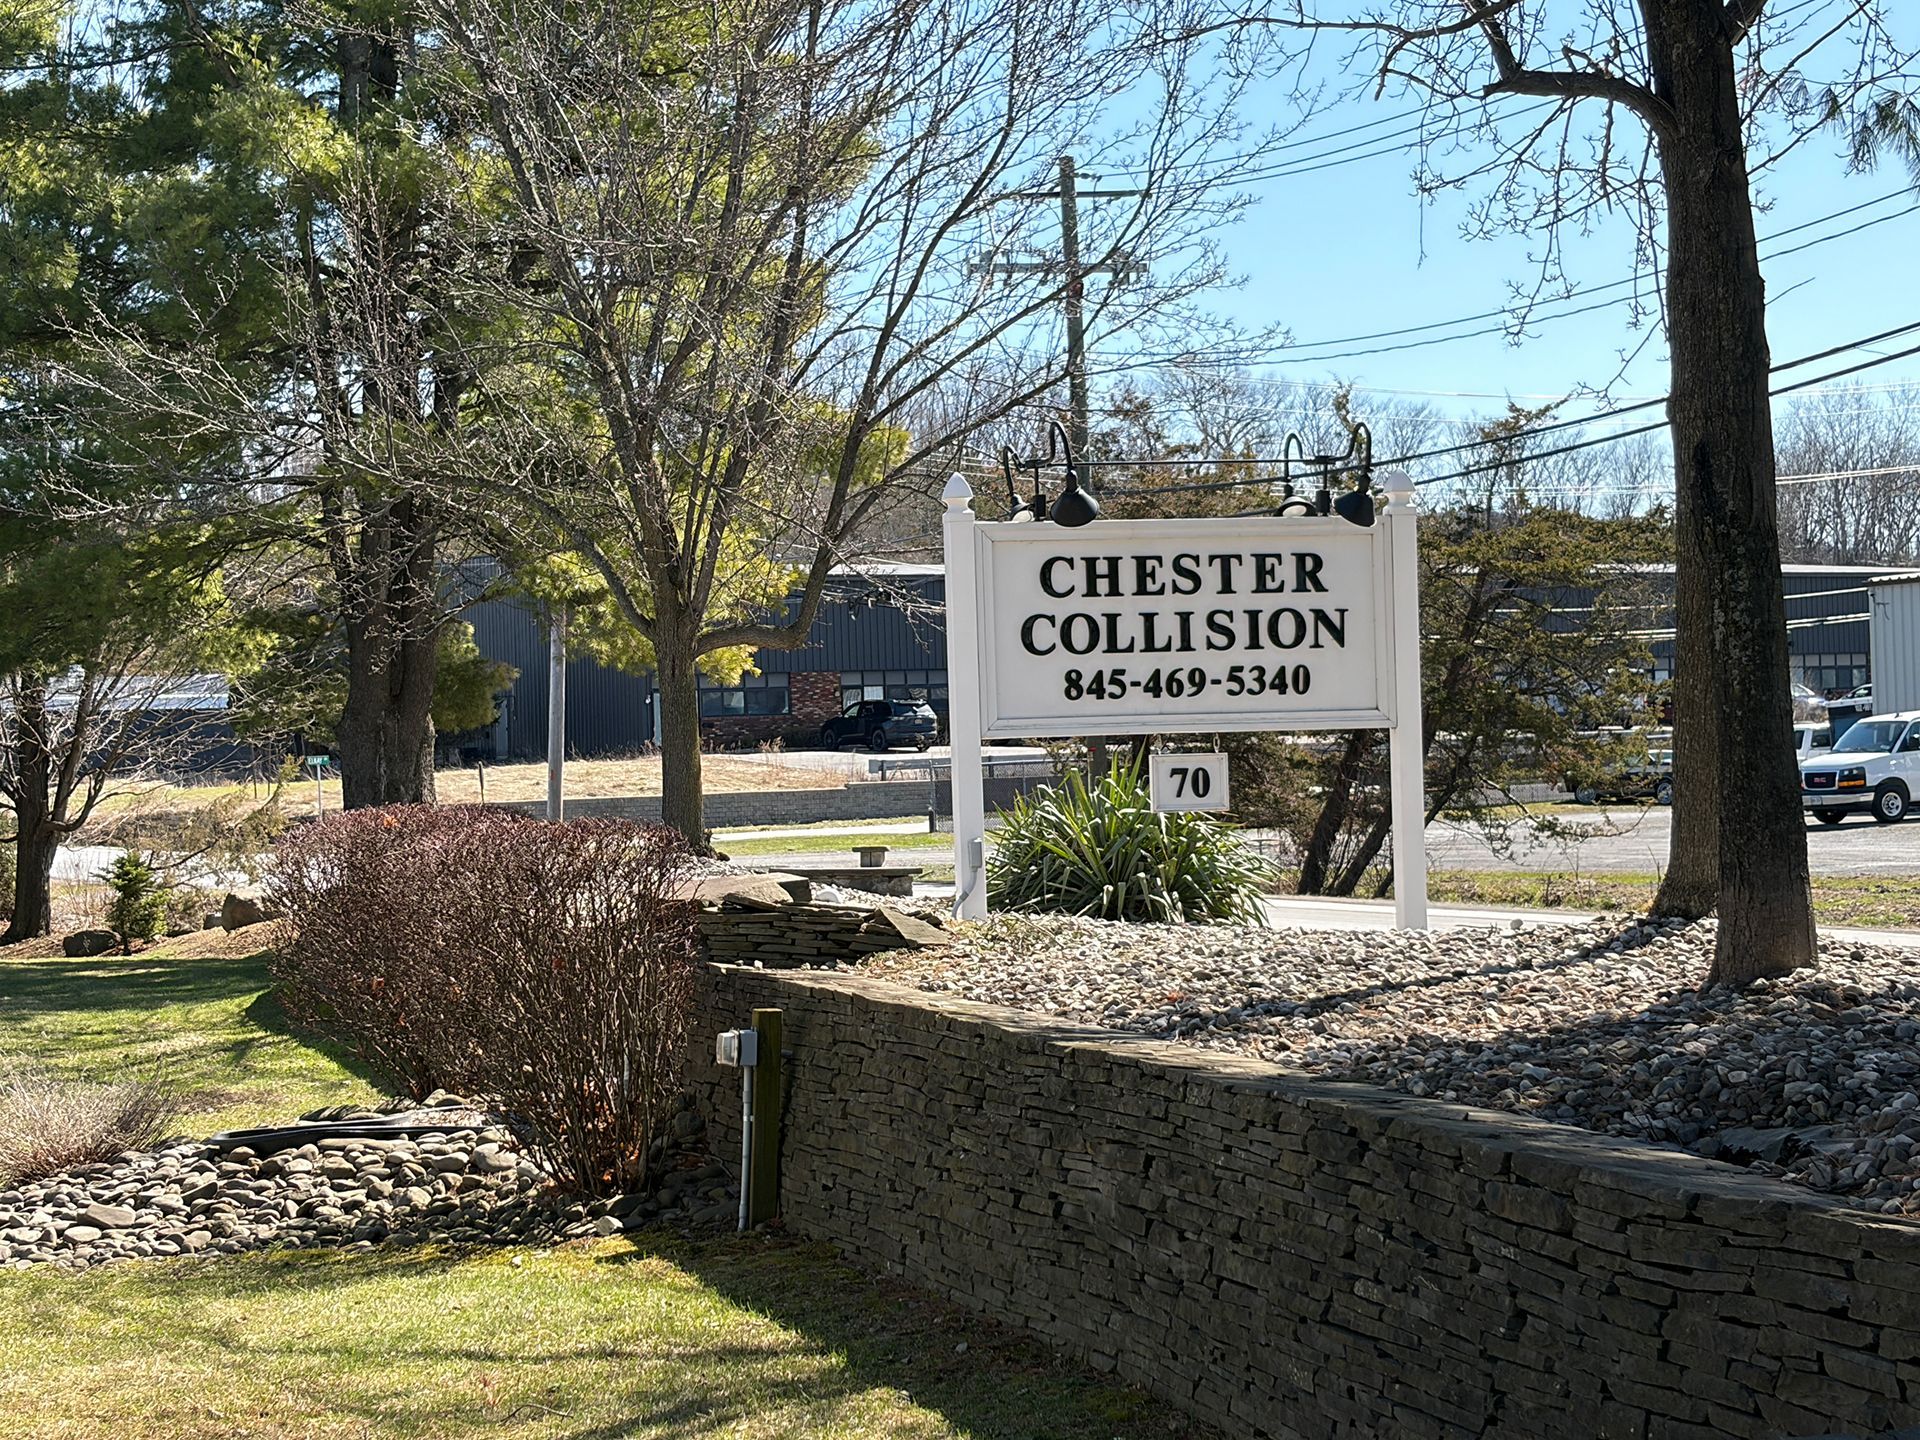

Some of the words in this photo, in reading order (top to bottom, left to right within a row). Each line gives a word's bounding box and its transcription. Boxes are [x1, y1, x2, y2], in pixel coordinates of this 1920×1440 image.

[1039, 552, 1328, 598] CHESTER
[1020, 608, 1349, 656] COLLISION
[1063, 663, 1311, 700] 845-469-5340
[1169, 766, 1211, 799] 70
